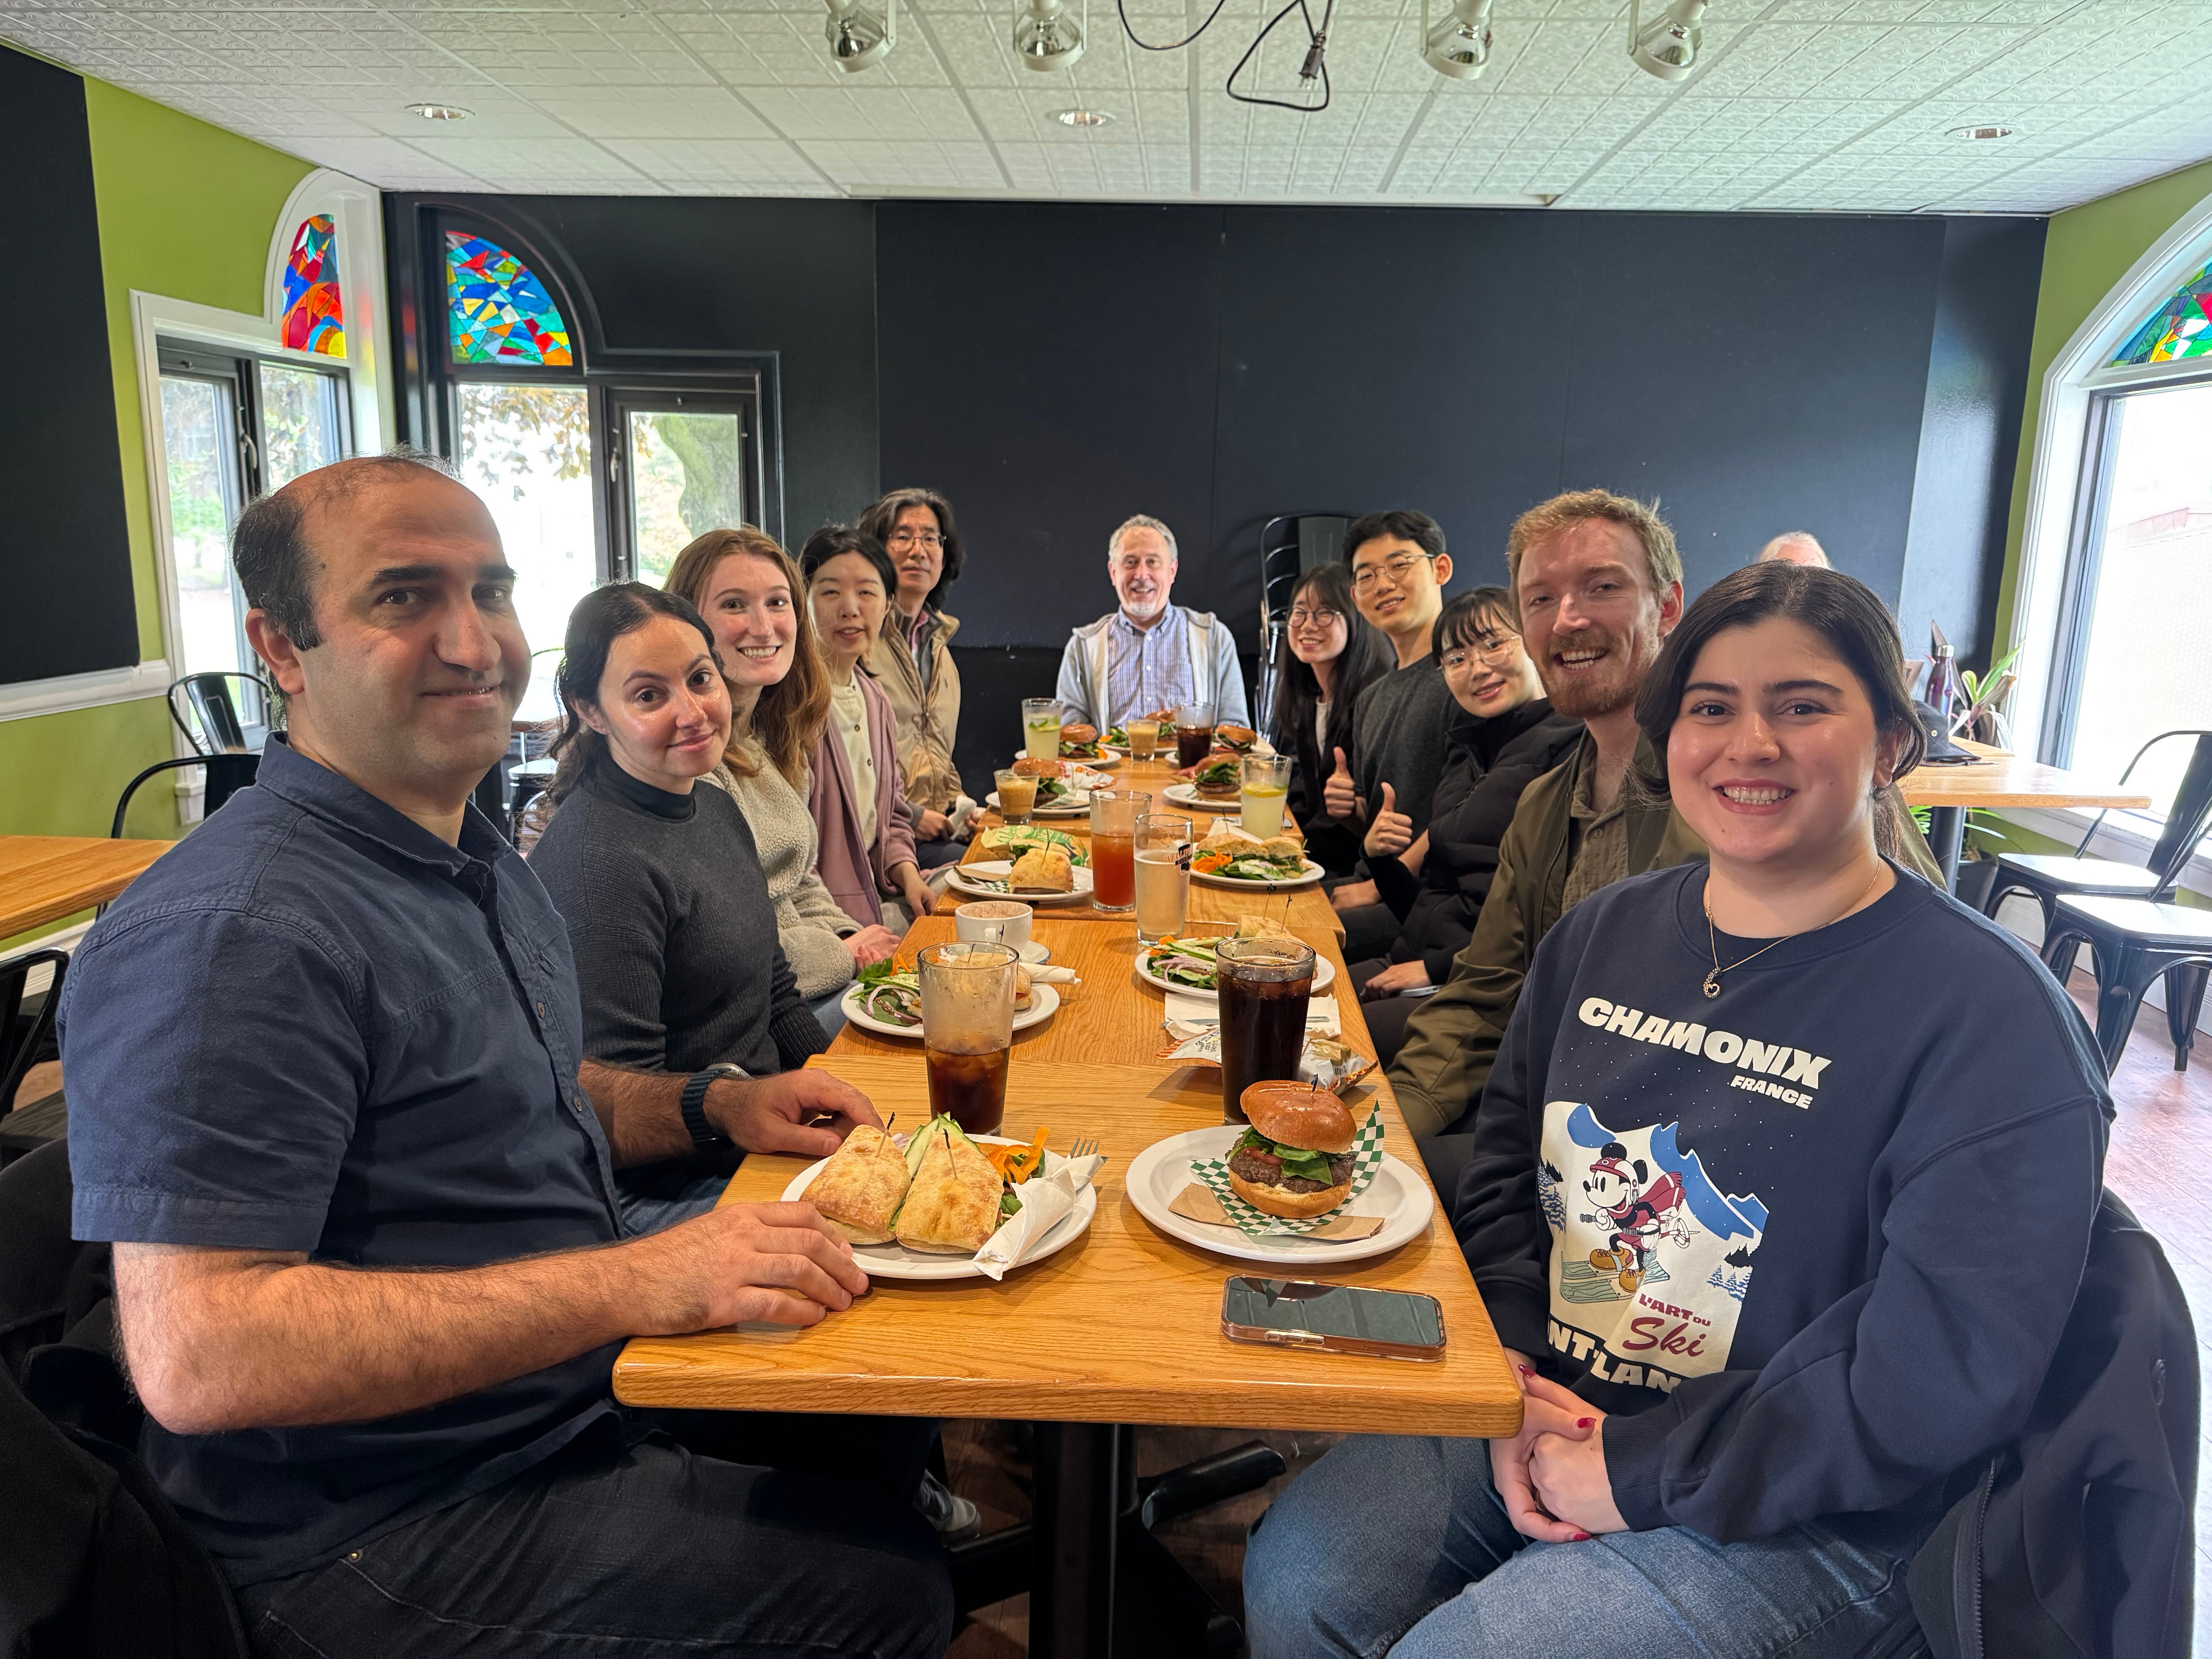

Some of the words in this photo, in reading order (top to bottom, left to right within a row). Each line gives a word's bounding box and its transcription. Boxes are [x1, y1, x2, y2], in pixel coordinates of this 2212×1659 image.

[1578, 997, 1832, 1089] CHAMONIX
[1730, 1075, 1813, 1109] FRANCE
[1638, 1293, 1693, 1320] L'ART
[1693, 1316, 1711, 1327] DU
[1622, 1317, 1707, 1357] Ski
